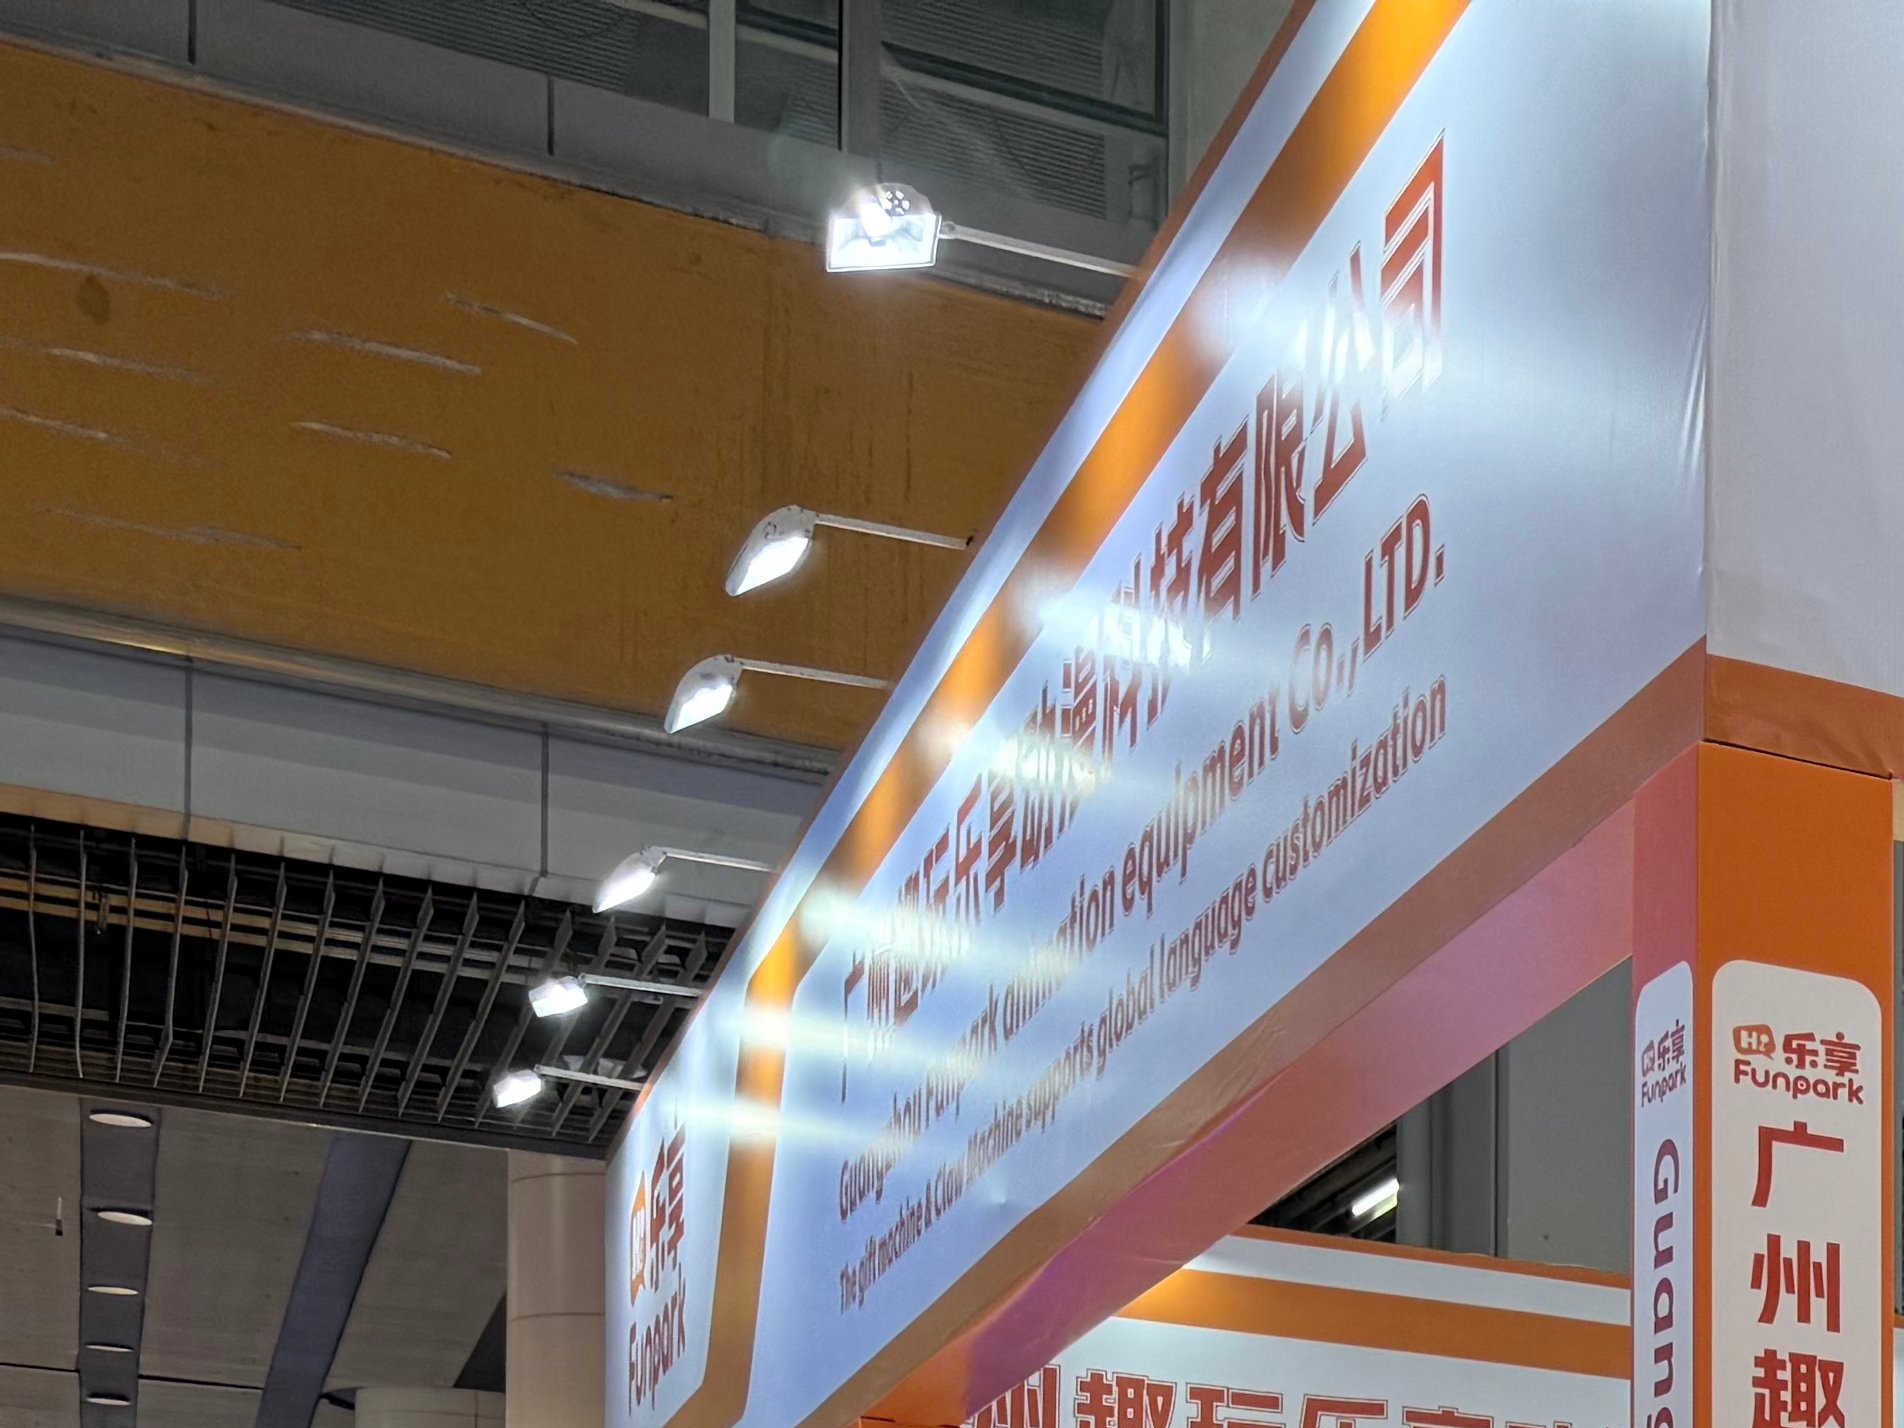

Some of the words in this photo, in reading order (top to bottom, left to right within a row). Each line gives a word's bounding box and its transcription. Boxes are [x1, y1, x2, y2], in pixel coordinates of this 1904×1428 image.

[1120, 676, 1282, 919] equipment
[1096, 943, 1156, 1081] global
[1149, 862, 1258, 1005] language
[1261, 673, 1448, 905] customization
[1640, 1062, 1687, 1108] Funpark
[1732, 1057, 1865, 1106] Funpark
[1781, 1030, 1862, 1077] 乐享
[628, 1262, 687, 1418] Funpark
